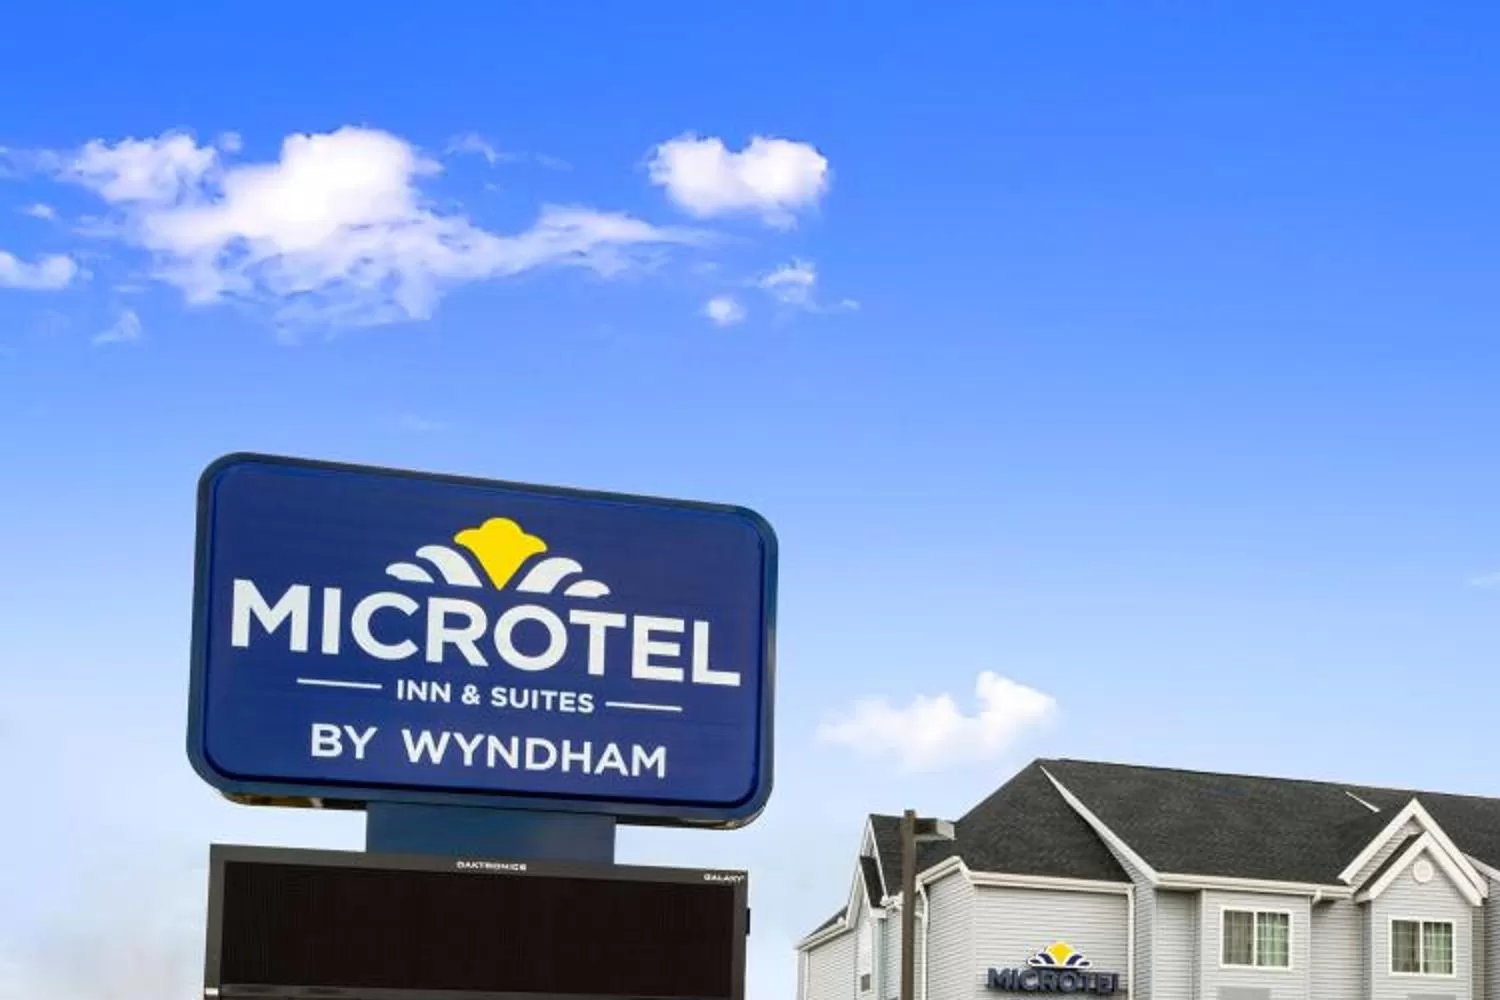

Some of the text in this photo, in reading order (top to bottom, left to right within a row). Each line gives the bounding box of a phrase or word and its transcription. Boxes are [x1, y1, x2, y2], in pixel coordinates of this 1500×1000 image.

[231, 579, 741, 686] MICROTEL
[397, 679, 594, 713] INN & SUITES
[311, 723, 666, 778] BY WYNDHAM
[987, 968, 1122, 994] MICROTEL
